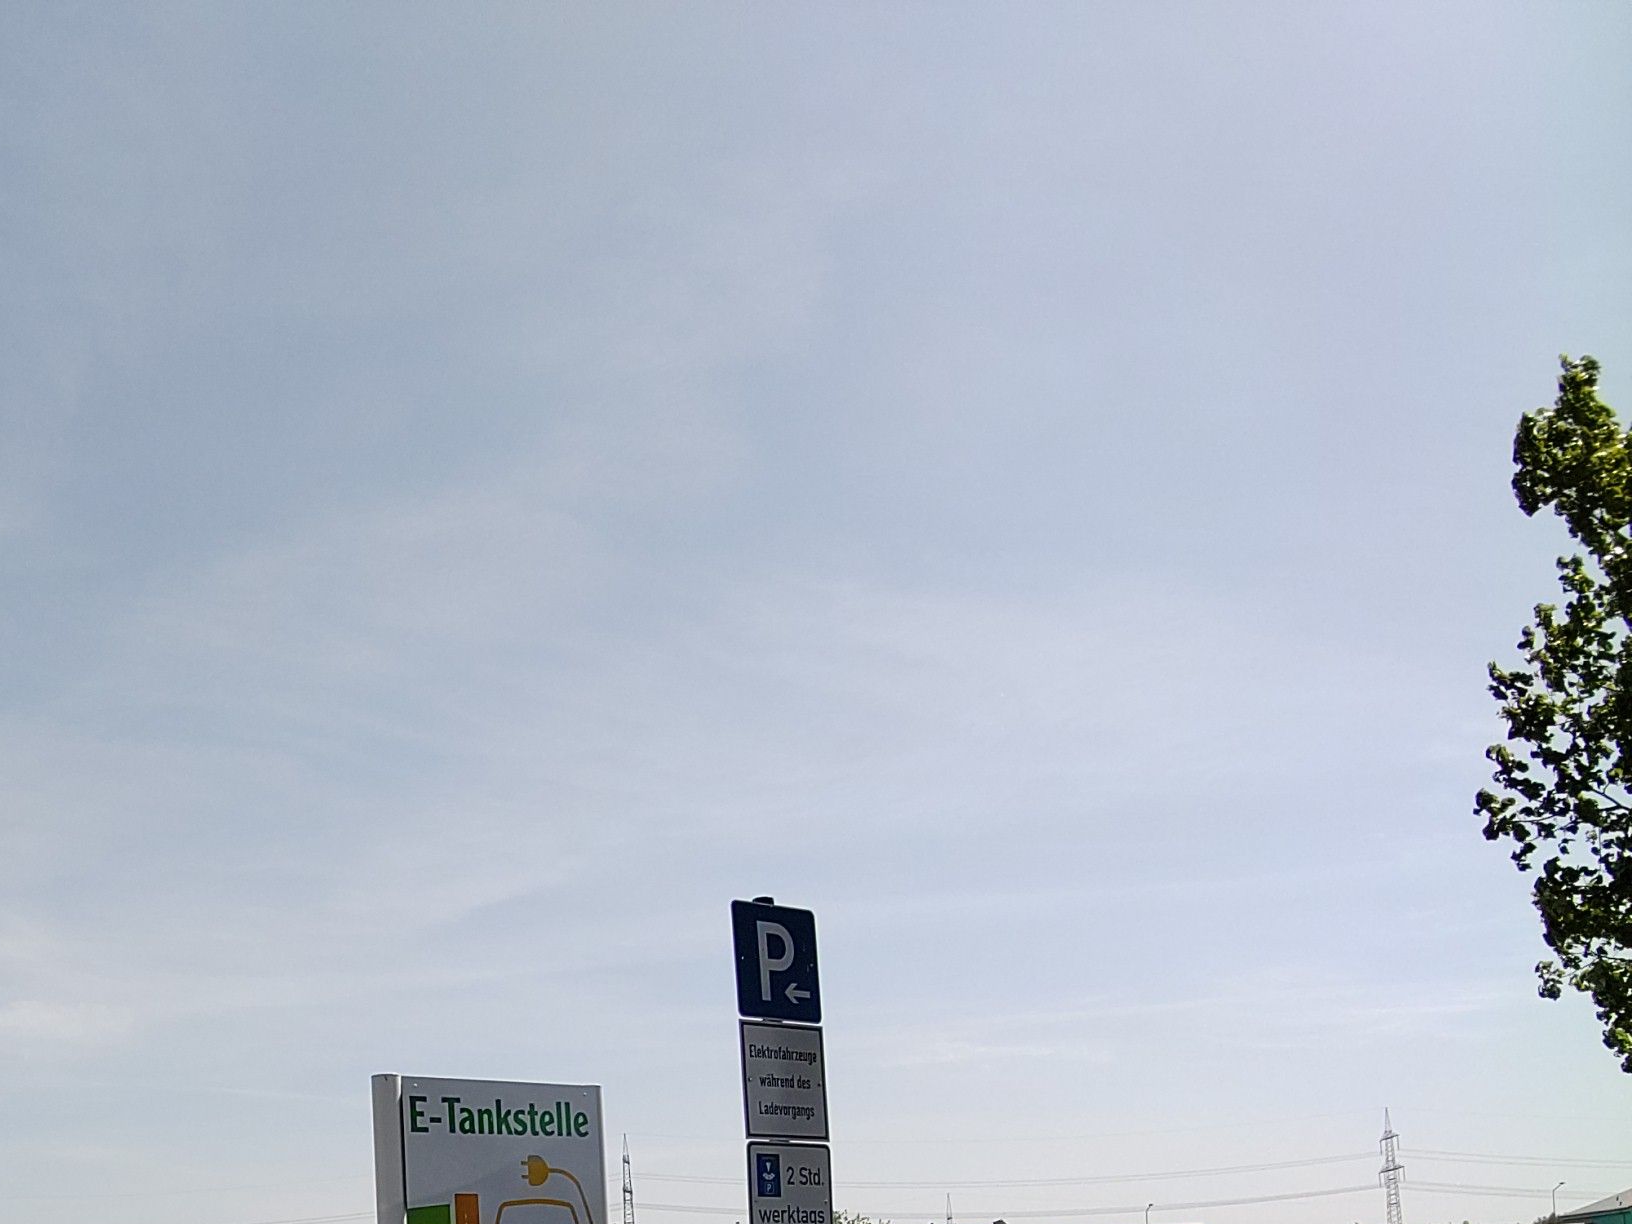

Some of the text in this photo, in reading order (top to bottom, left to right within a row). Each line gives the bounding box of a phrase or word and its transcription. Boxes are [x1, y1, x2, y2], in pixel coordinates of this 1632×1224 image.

[756, 920, 795, 1001] P
[749, 1043, 818, 1066] Elektrofahrzeuge
[759, 1073, 811, 1089] während des
[408, 1095, 589, 1138] E-Tankstelle
[758, 1100, 815, 1120] Ladevorgangs
[786, 1166, 825, 1186] 2 Std.
